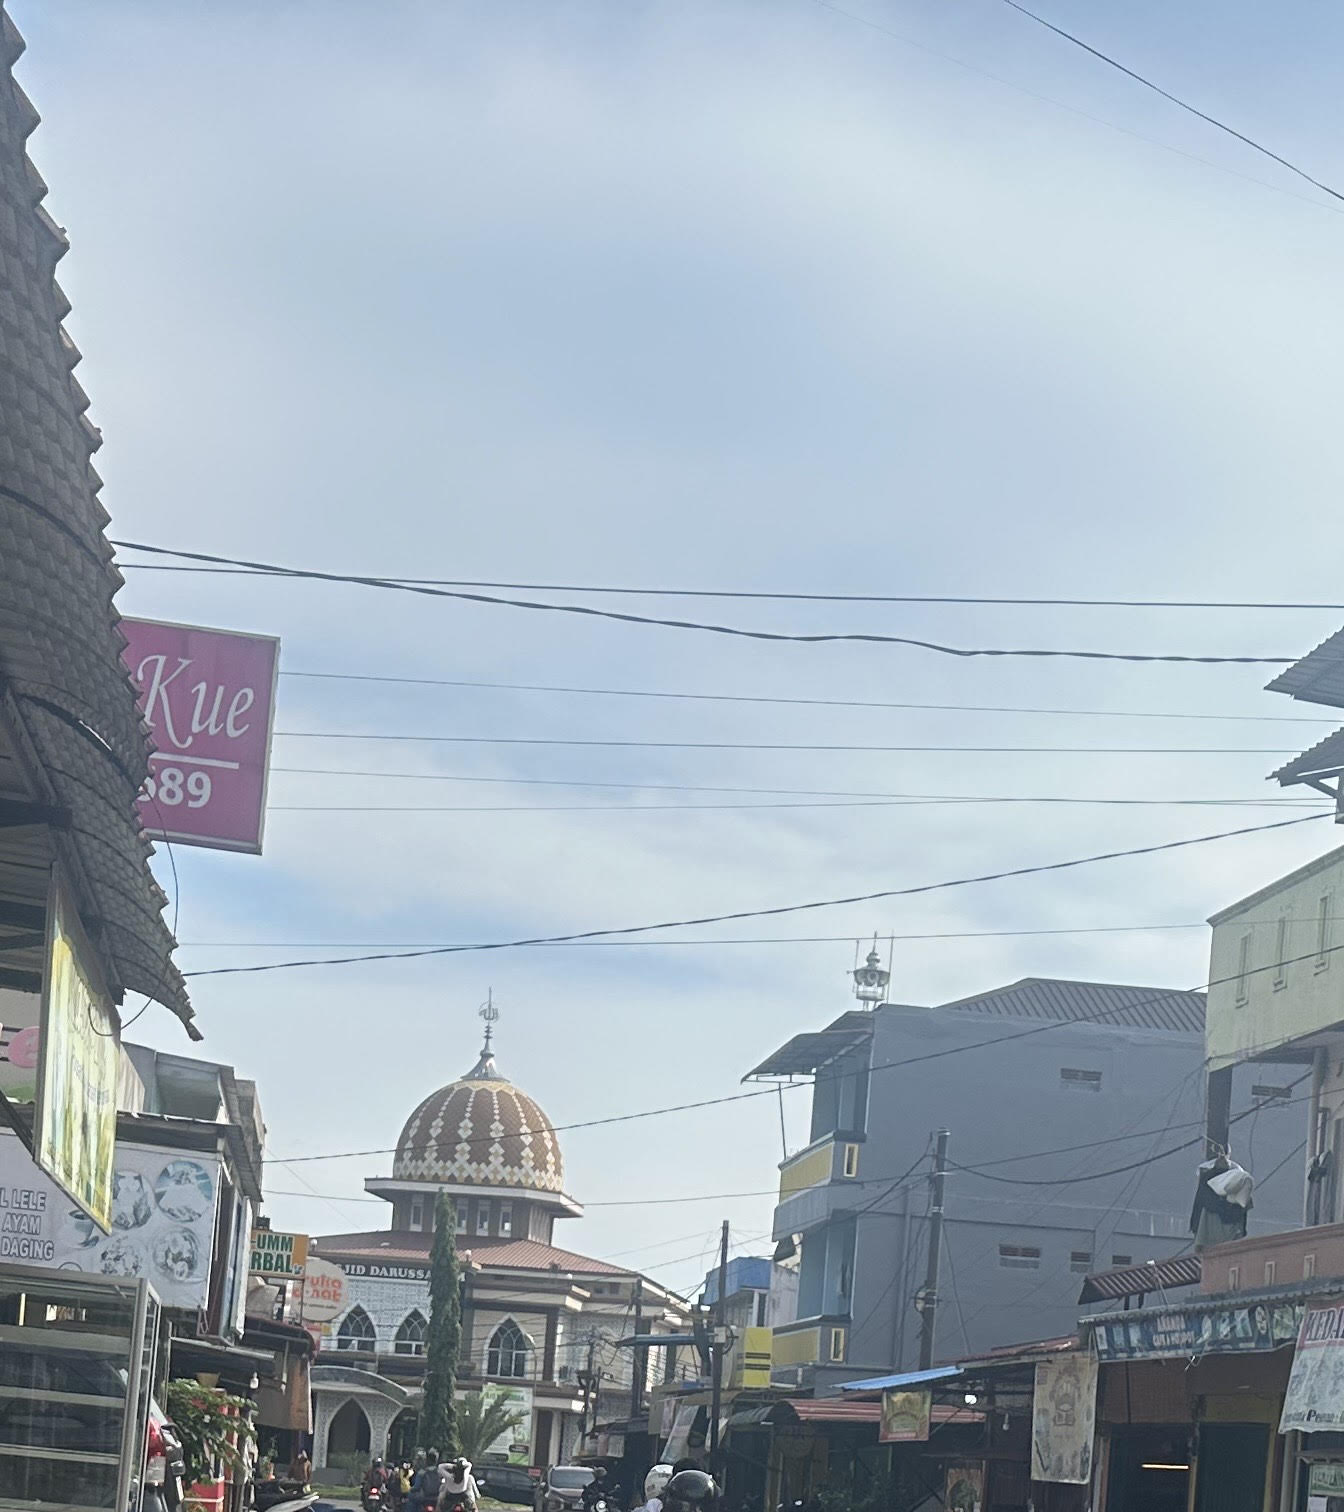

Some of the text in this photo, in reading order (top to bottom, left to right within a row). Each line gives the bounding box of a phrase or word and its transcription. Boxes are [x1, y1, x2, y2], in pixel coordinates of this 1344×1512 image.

[136, 654, 255, 750] Kue
[12, 1188, 47, 1212] LELE
[2, 1212, 41, 1236] AYAM
[0, 1236, 55, 1261] DAGING
